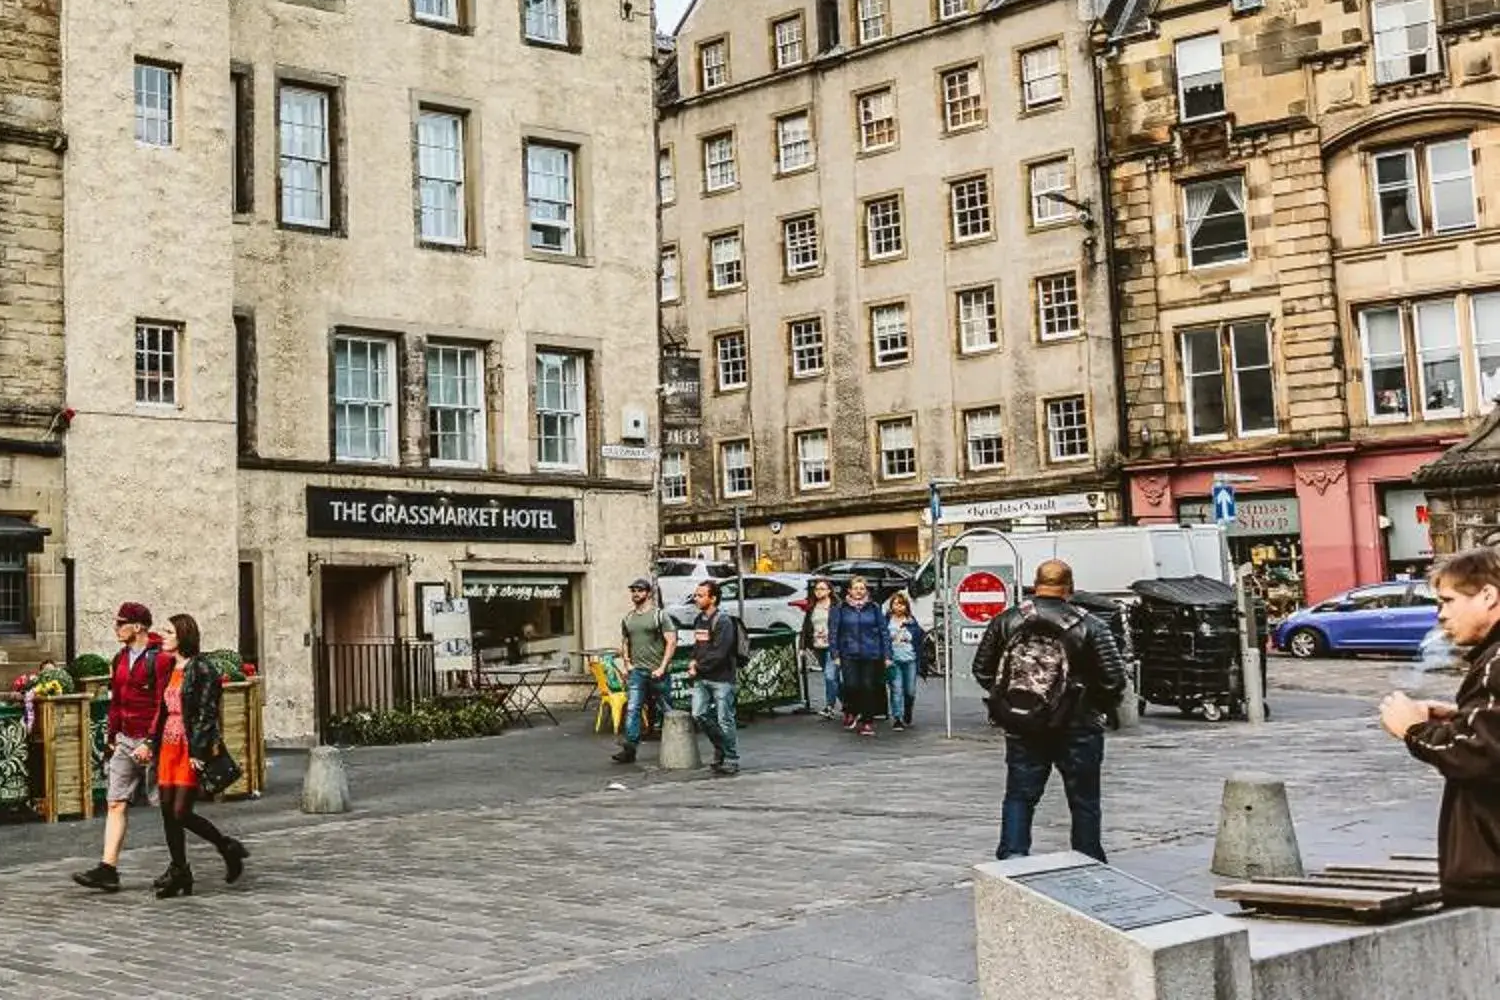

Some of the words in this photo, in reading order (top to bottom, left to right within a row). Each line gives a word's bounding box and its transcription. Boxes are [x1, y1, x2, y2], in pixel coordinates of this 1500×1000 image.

[330, 501, 367, 522] THE
[370, 503, 500, 527] GRASSMARKET
[503, 508, 558, 529] HOTEL
